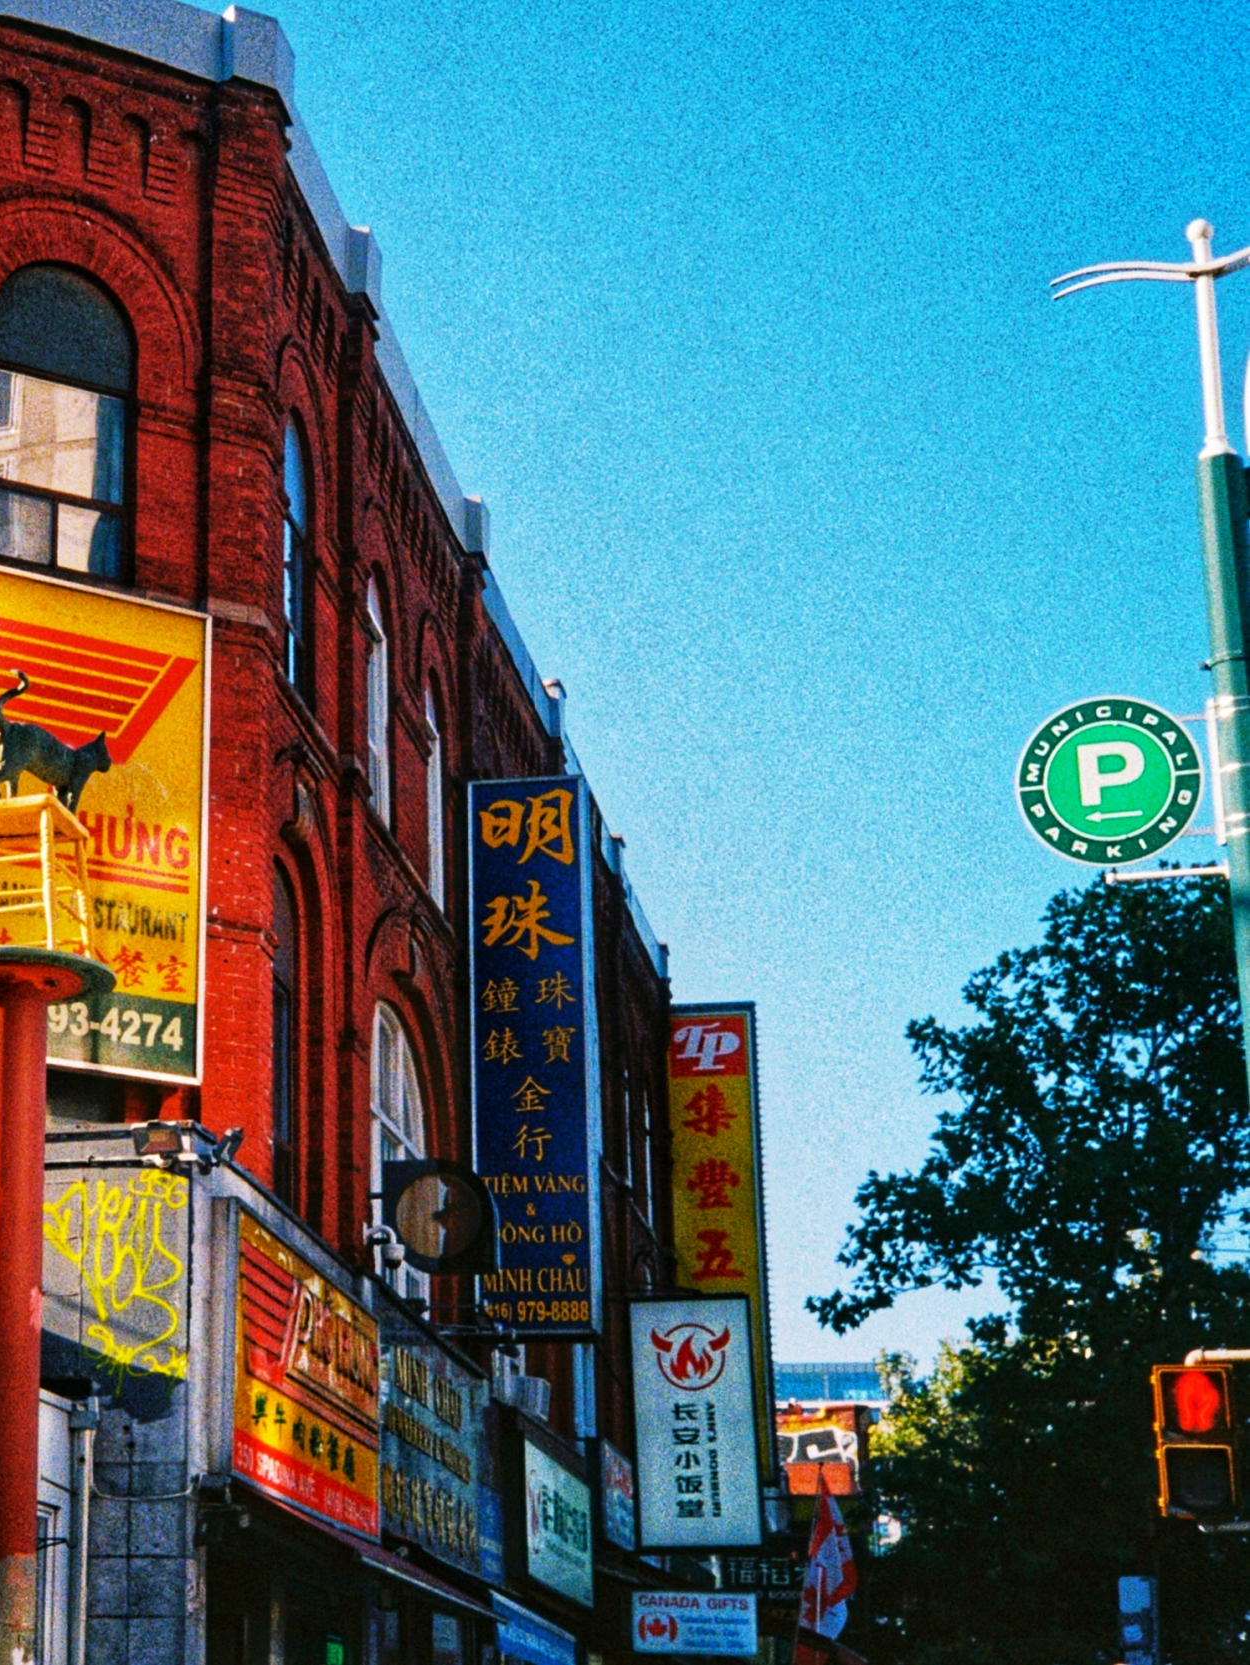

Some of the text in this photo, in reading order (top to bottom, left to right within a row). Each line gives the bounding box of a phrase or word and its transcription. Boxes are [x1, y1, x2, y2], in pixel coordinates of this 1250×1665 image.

[1026, 706, 1188, 782] MUNICIPAL
[1077, 741, 1145, 807] P
[1030, 789, 1192, 858] PARKING
[479, 788, 575, 961] 明珠
[511, 1075, 553, 1162] 金行
[526, 1203, 536, 1217] &
[483, 1268, 532, 1293] MINH
[517, 1300, 589, 1322] 979-8888
[671, 1402, 705, 1518] 长安小饭堂
[637, 1594, 749, 1611] CANADA GIFTS
